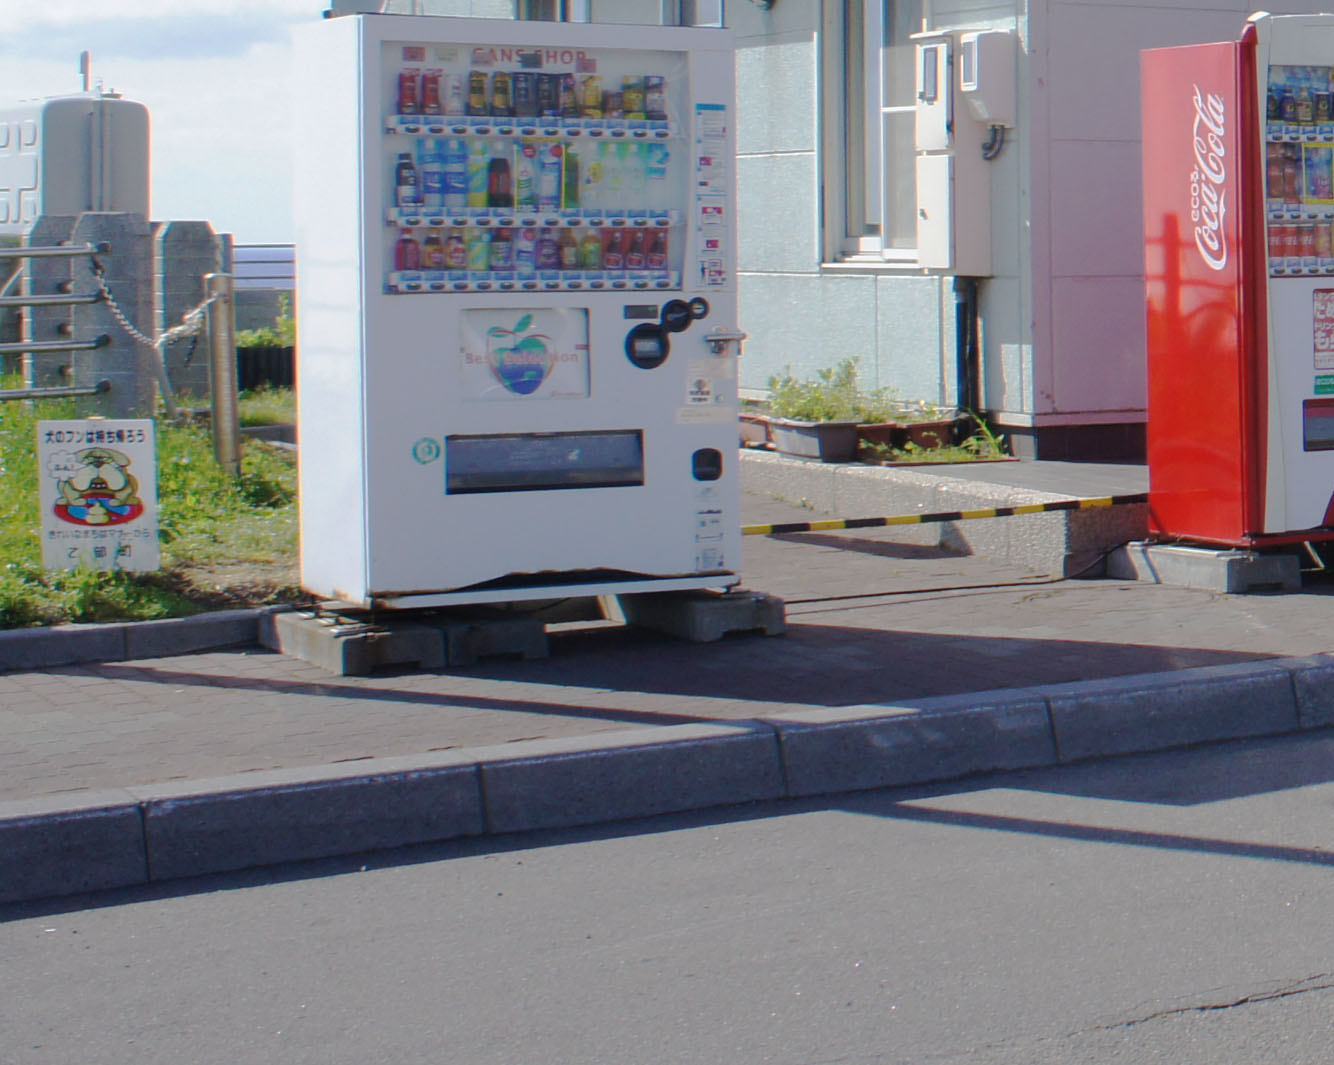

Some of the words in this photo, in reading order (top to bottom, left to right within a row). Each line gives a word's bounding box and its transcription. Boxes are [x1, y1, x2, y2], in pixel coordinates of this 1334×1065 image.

[1193, 83, 1227, 271] Coca-Cola
[45, 429, 146, 444] 犬のフンは持ち帰ろう
